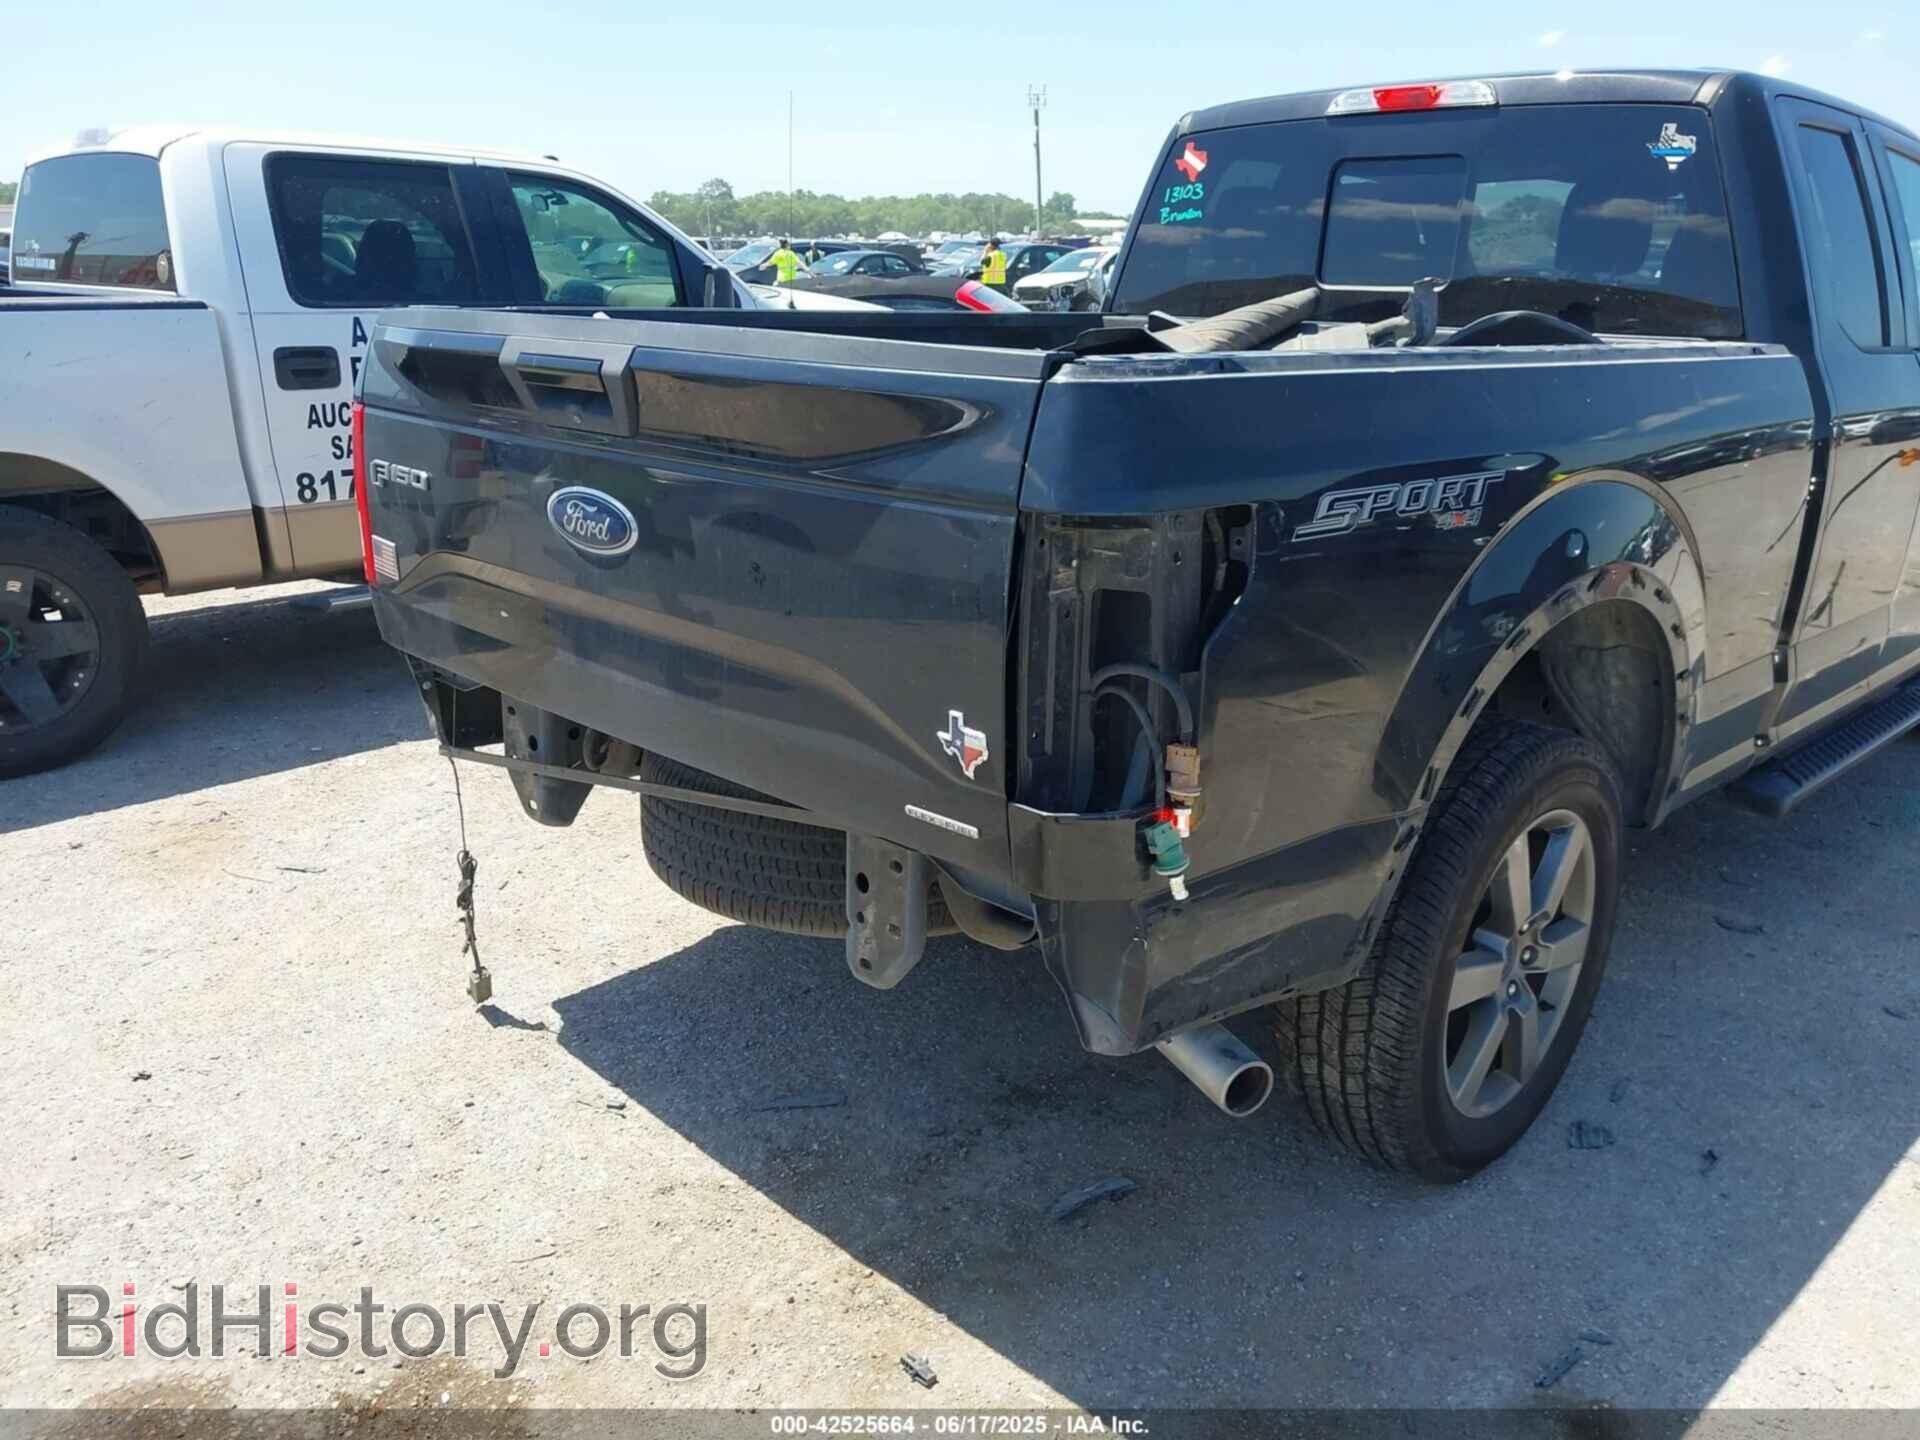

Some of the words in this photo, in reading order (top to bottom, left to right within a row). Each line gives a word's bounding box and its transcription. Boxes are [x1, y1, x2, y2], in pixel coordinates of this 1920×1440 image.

[1164, 183, 1204, 203] 13103
[352, 316, 368, 347] A
[307, 401, 354, 429] AUC
[296, 469, 356, 503] 817
[563, 500, 610, 541] Ford
[1291, 470, 1506, 542] SPORT
